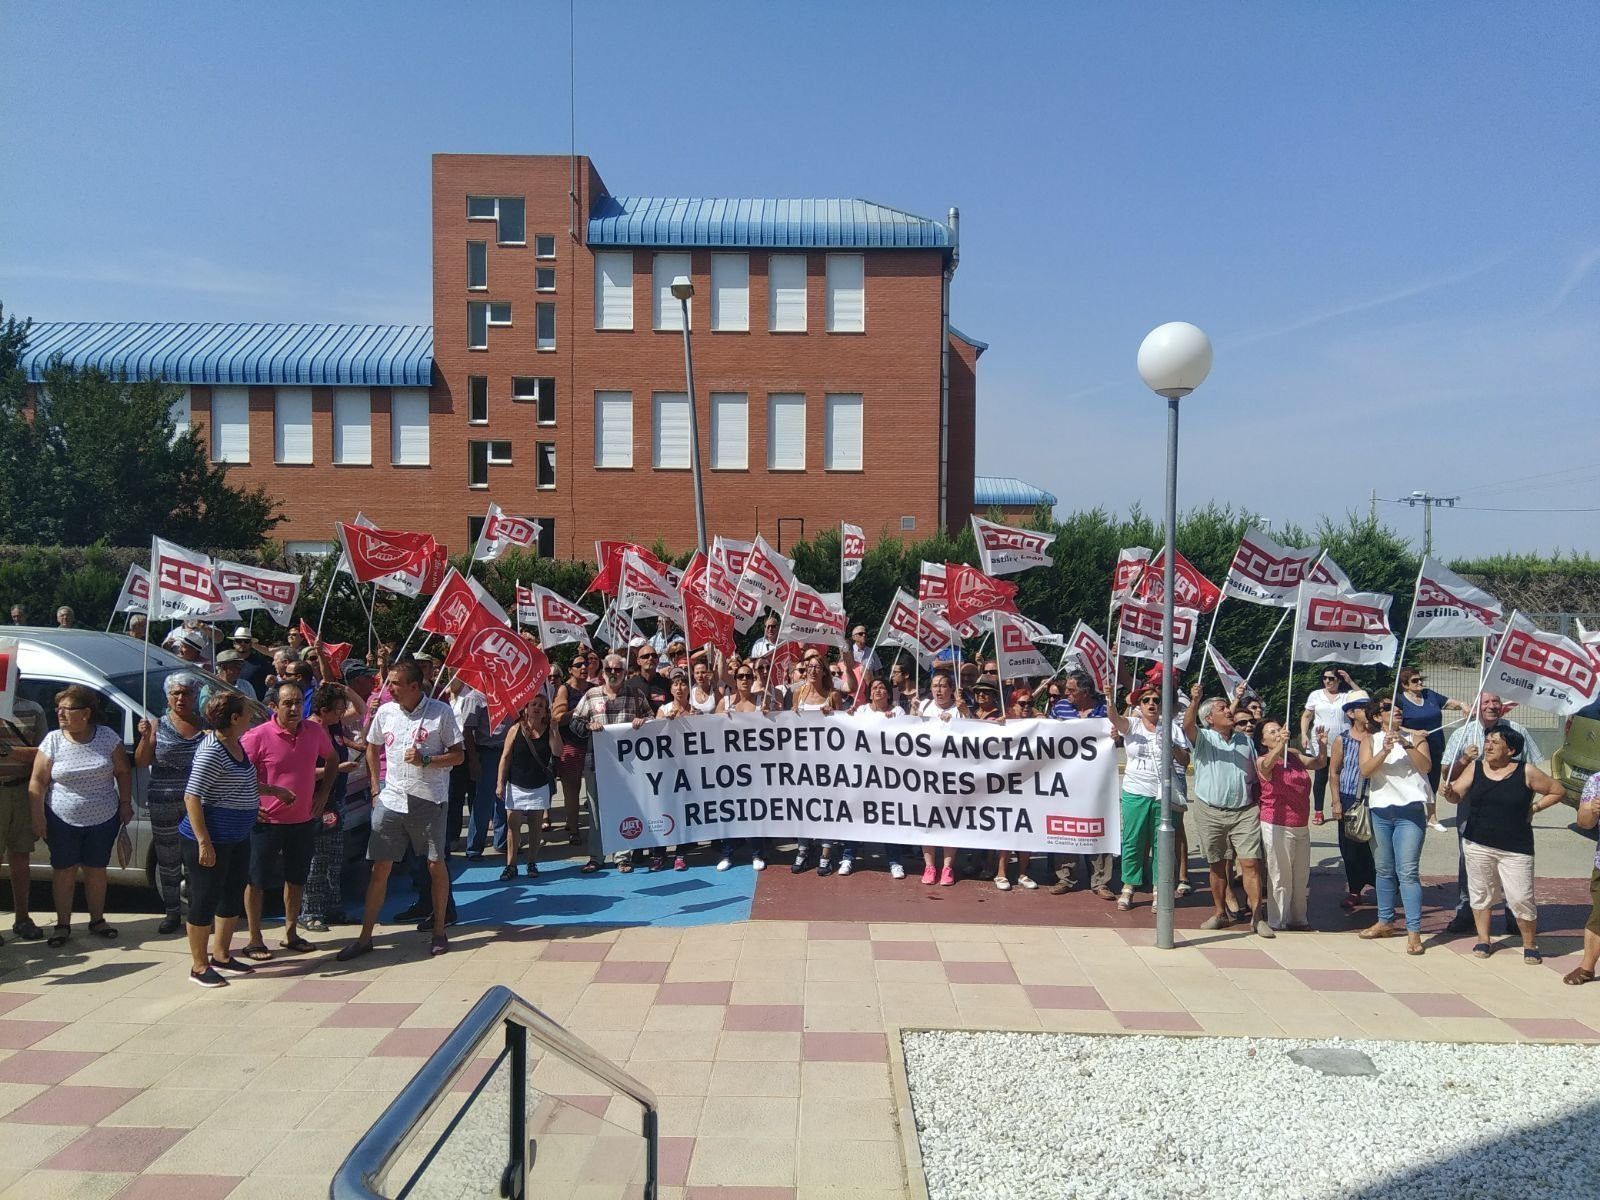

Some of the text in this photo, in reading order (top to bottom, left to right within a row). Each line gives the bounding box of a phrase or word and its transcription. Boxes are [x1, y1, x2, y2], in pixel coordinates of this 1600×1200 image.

[230, 594, 260, 602] astilla
[1228, 577, 1258, 597] astilla
[1416, 607, 1460, 618] astilla
[480, 631, 530, 677] UGT
[1343, 642, 1350, 651] y
[1353, 641, 1384, 652] León
[1506, 636, 1594, 691] CCOO
[1500, 671, 1535, 691] Castilla
[1536, 686, 1546, 696] y
[617, 727, 1098, 762] POR EL RESPETO A LOS ANCIANOS
[646, 762, 1069, 798] Y A LOS TRABAJADORES DE LA
[623, 819, 641, 831] UGT
[685, 798, 1034, 833] RESIDENCIA BELLAVISTA
[1050, 820, 1101, 833] CCOO
